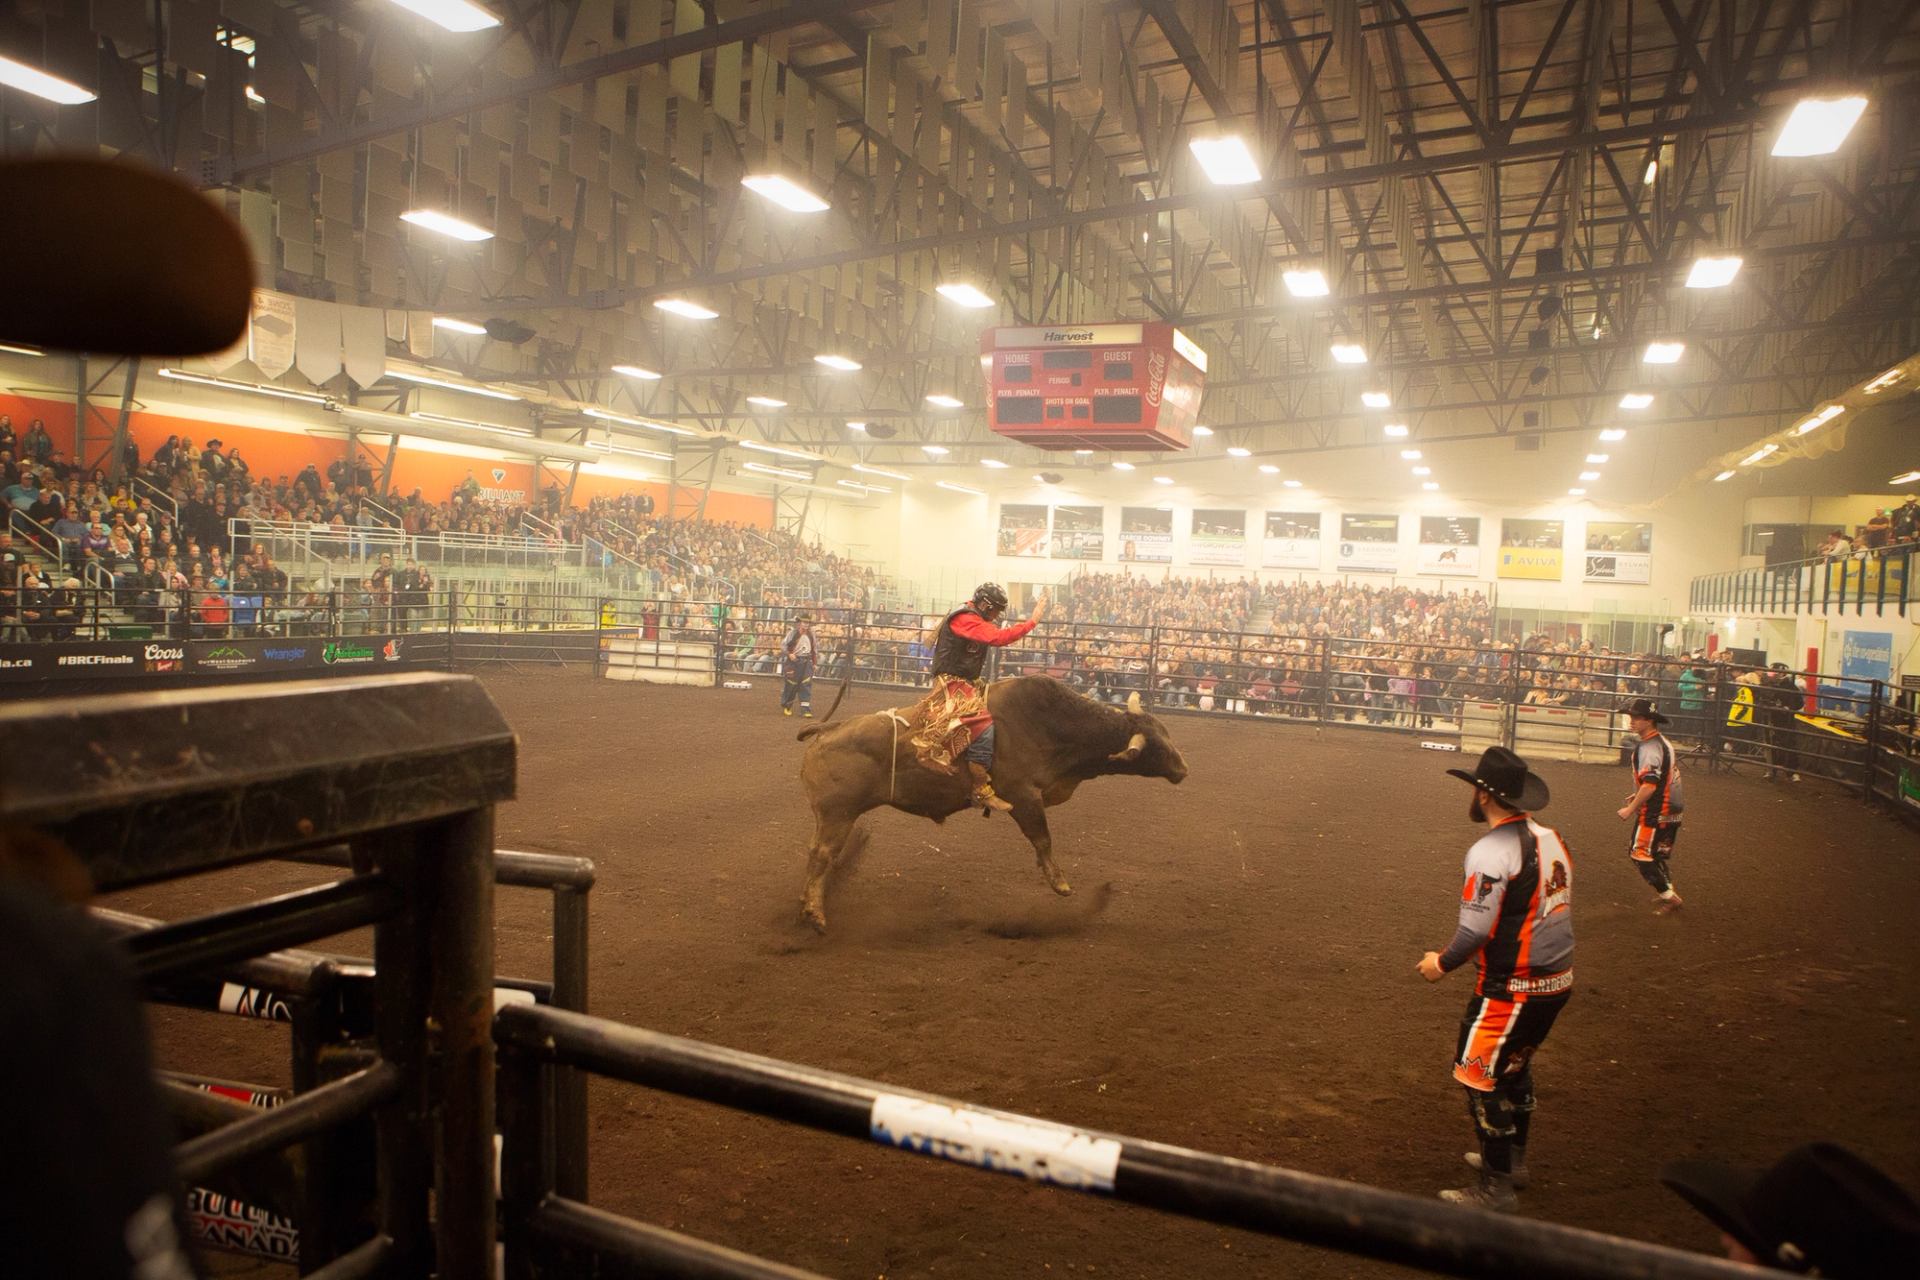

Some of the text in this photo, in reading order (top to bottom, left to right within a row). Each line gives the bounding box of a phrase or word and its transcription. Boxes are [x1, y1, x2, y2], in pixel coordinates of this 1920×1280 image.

[1044, 331, 1094, 342] Harvest
[1005, 354, 1030, 363] HOME
[1103, 351, 1133, 361] GUEST
[1048, 377, 1071, 385] PERIOD
[1015, 388, 1040, 396] PENALTY
[478, 487, 525, 502] RILLIANT
[1518, 556, 1557, 567] AVIVA
[144, 644, 184, 660] Coors
[264, 648, 305, 661] Wrangler
[58, 655, 134, 666] #BRCFinals
